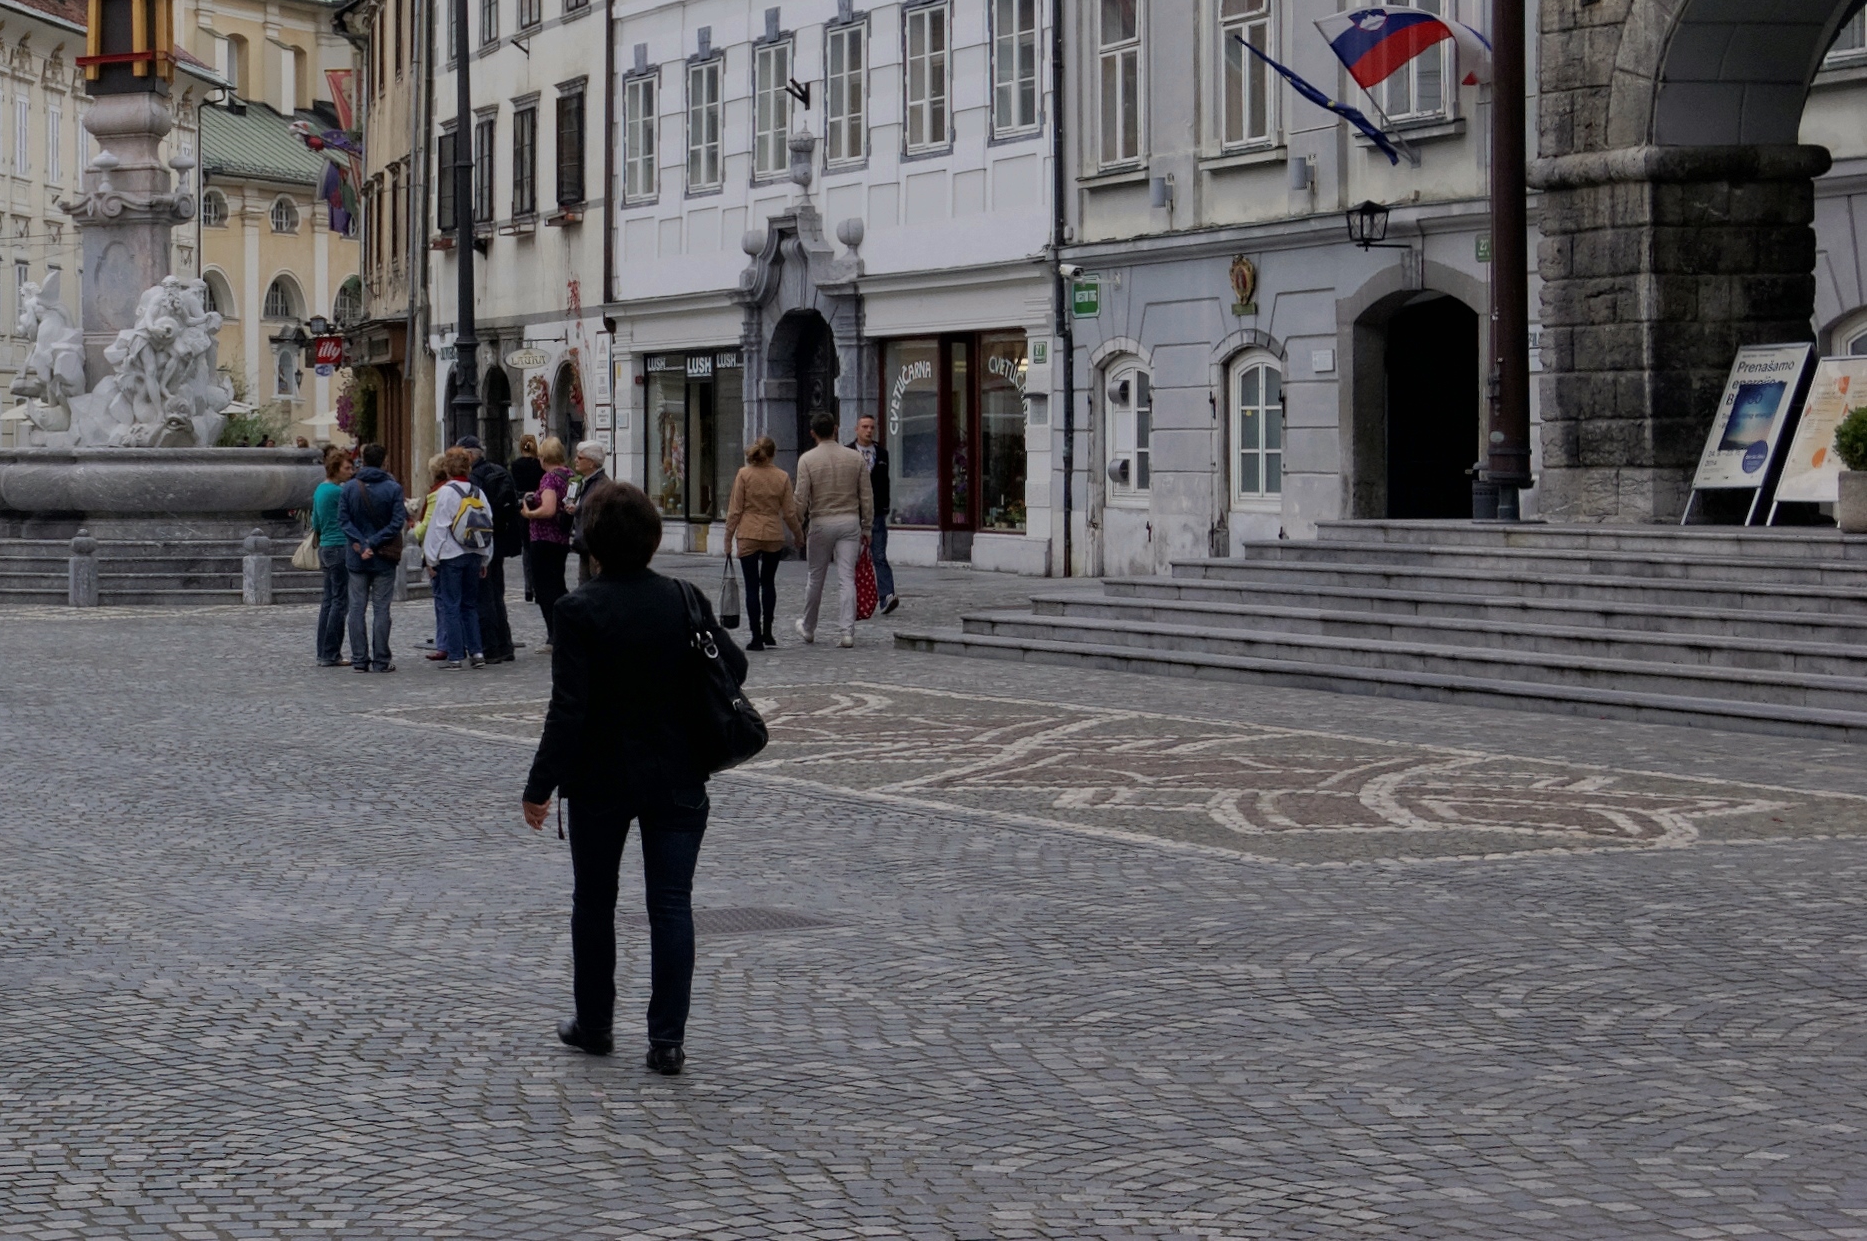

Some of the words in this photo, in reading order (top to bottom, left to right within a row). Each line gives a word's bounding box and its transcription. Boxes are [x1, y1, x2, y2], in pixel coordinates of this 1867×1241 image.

[317, 341, 342, 361] illy
[511, 355, 546, 366] LAURA
[647, 357, 666, 372] LUSH
[687, 357, 711, 373] LUSH
[716, 353, 737, 368] LUSH
[1736, 360, 1795, 374] Prenašamo
